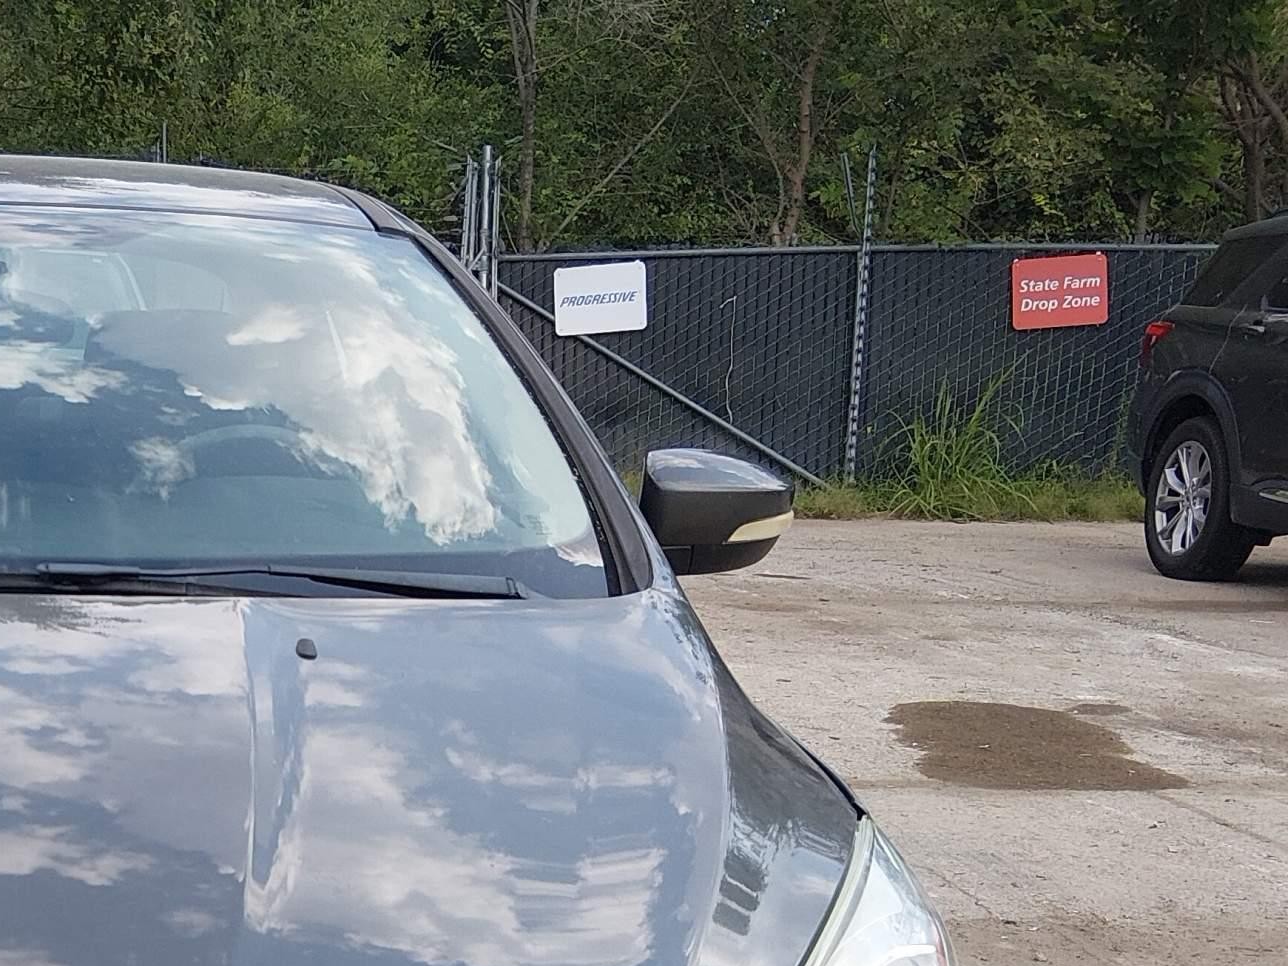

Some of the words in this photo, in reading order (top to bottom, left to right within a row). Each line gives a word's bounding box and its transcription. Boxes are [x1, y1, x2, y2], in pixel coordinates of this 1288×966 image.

[1019, 278, 1059, 293] State
[1063, 276, 1101, 290] Farm
[559, 290, 638, 308] PROGRESSIVE
[1020, 298, 1058, 313] Drop
[1062, 295, 1100, 309] Zone
